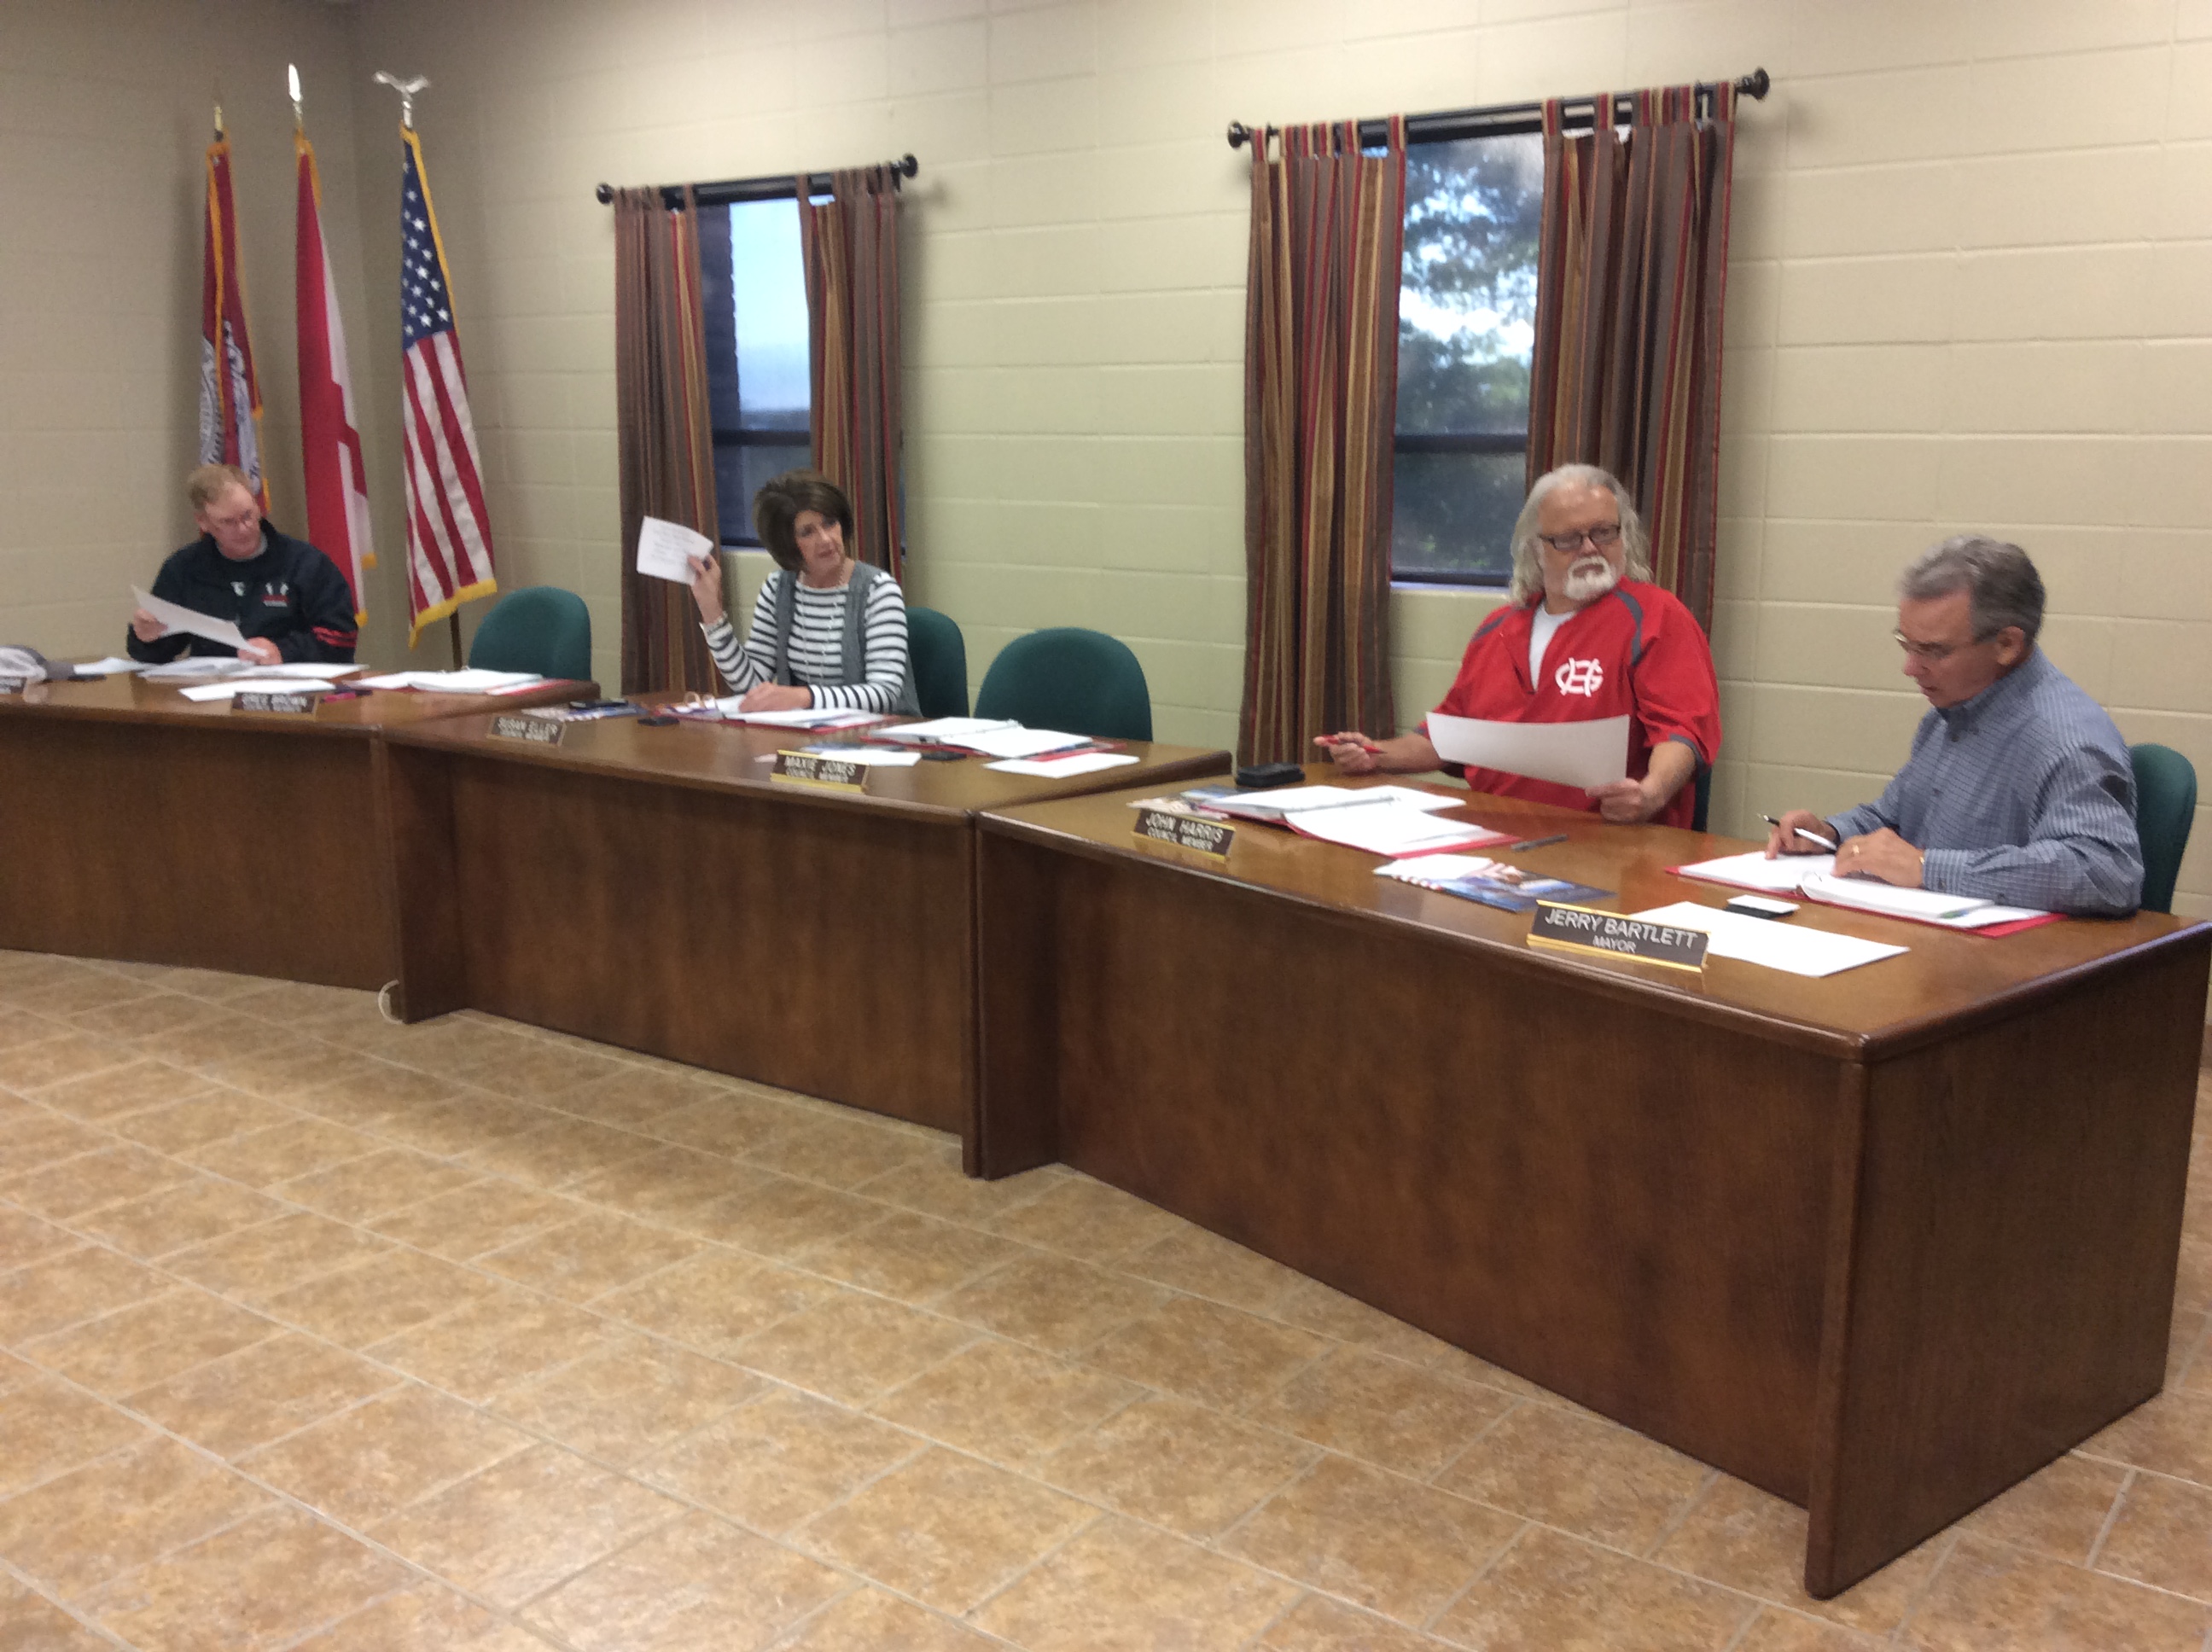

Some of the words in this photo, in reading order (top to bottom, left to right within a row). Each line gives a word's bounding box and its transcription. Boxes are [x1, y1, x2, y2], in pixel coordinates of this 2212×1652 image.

[784, 755, 818, 772] MAXIE
[821, 759, 856, 777] JONES
[1145, 812, 1176, 831] JOHN
[1179, 820, 1224, 844] HARRIS
[1147, 826, 1178, 843] COUNCIL
[1545, 908, 1603, 932] JERRY
[1604, 917, 1698, 950] BARTLETT
[1592, 935, 1637, 954] MAYOR
